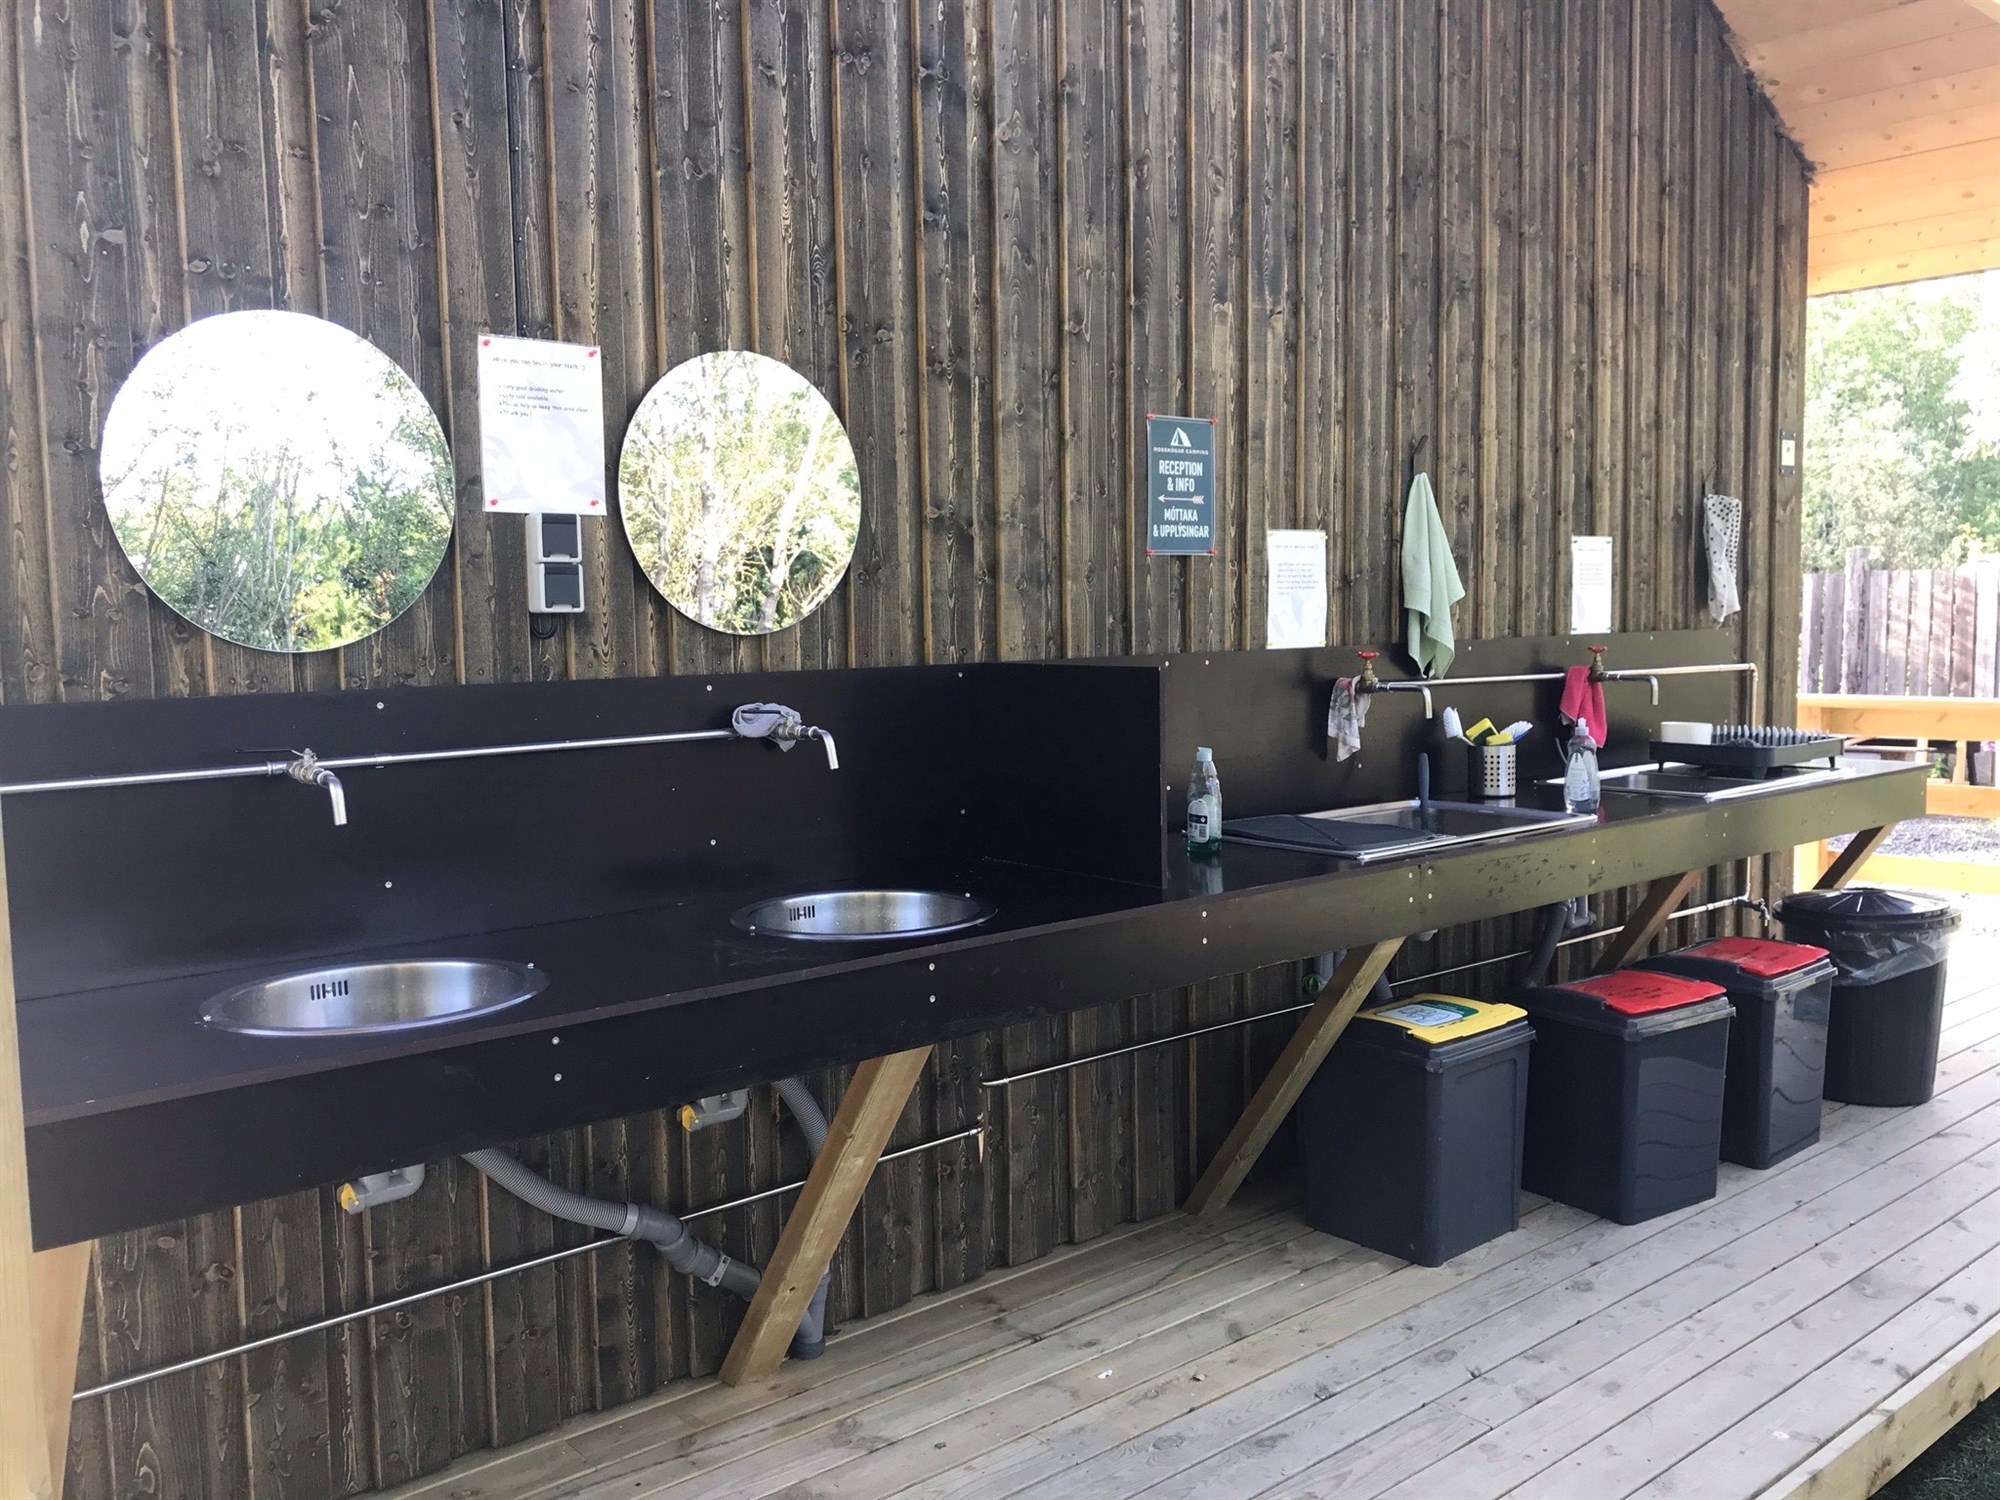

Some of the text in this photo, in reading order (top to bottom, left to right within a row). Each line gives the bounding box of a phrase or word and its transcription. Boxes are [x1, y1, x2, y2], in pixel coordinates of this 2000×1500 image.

[550, 362, 562, 370] your
[528, 386, 549, 394] drinking
[527, 394, 549, 402] available
[538, 402, 551, 411] keep
[552, 403, 562, 411] this
[1159, 460, 1203, 476] RECEPTION
[1167, 477, 1195, 492] & INFO
[1164, 505, 1198, 522] MÓTTAKA
[1153, 522, 1210, 538] & UPPLÝSINGAR
